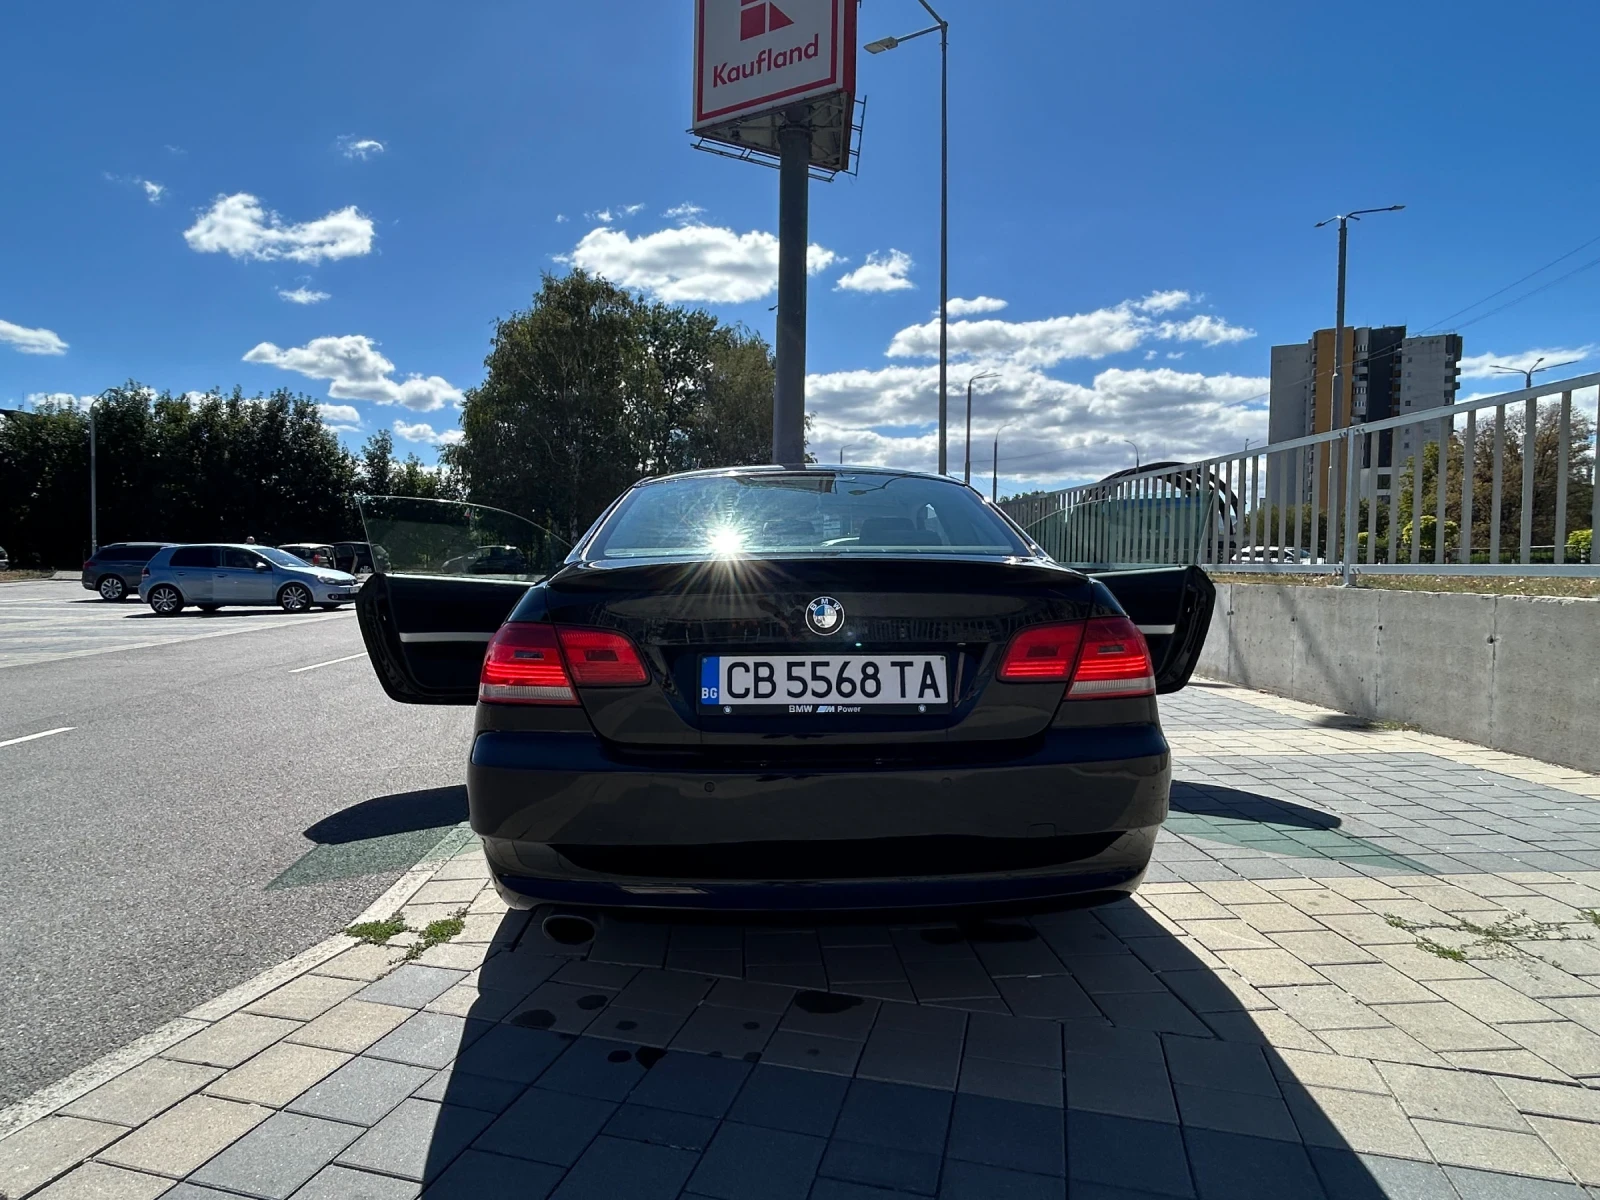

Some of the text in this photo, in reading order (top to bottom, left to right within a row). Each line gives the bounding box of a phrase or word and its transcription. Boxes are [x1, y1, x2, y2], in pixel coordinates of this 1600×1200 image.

[713, 33, 819, 88] Kaufland
[809, 598, 841, 611] BMW
[727, 661, 941, 699] CB 5568 TA
[701, 687, 718, 699] BG
[788, 704, 813, 713] BMW
[837, 705, 862, 713] Power
